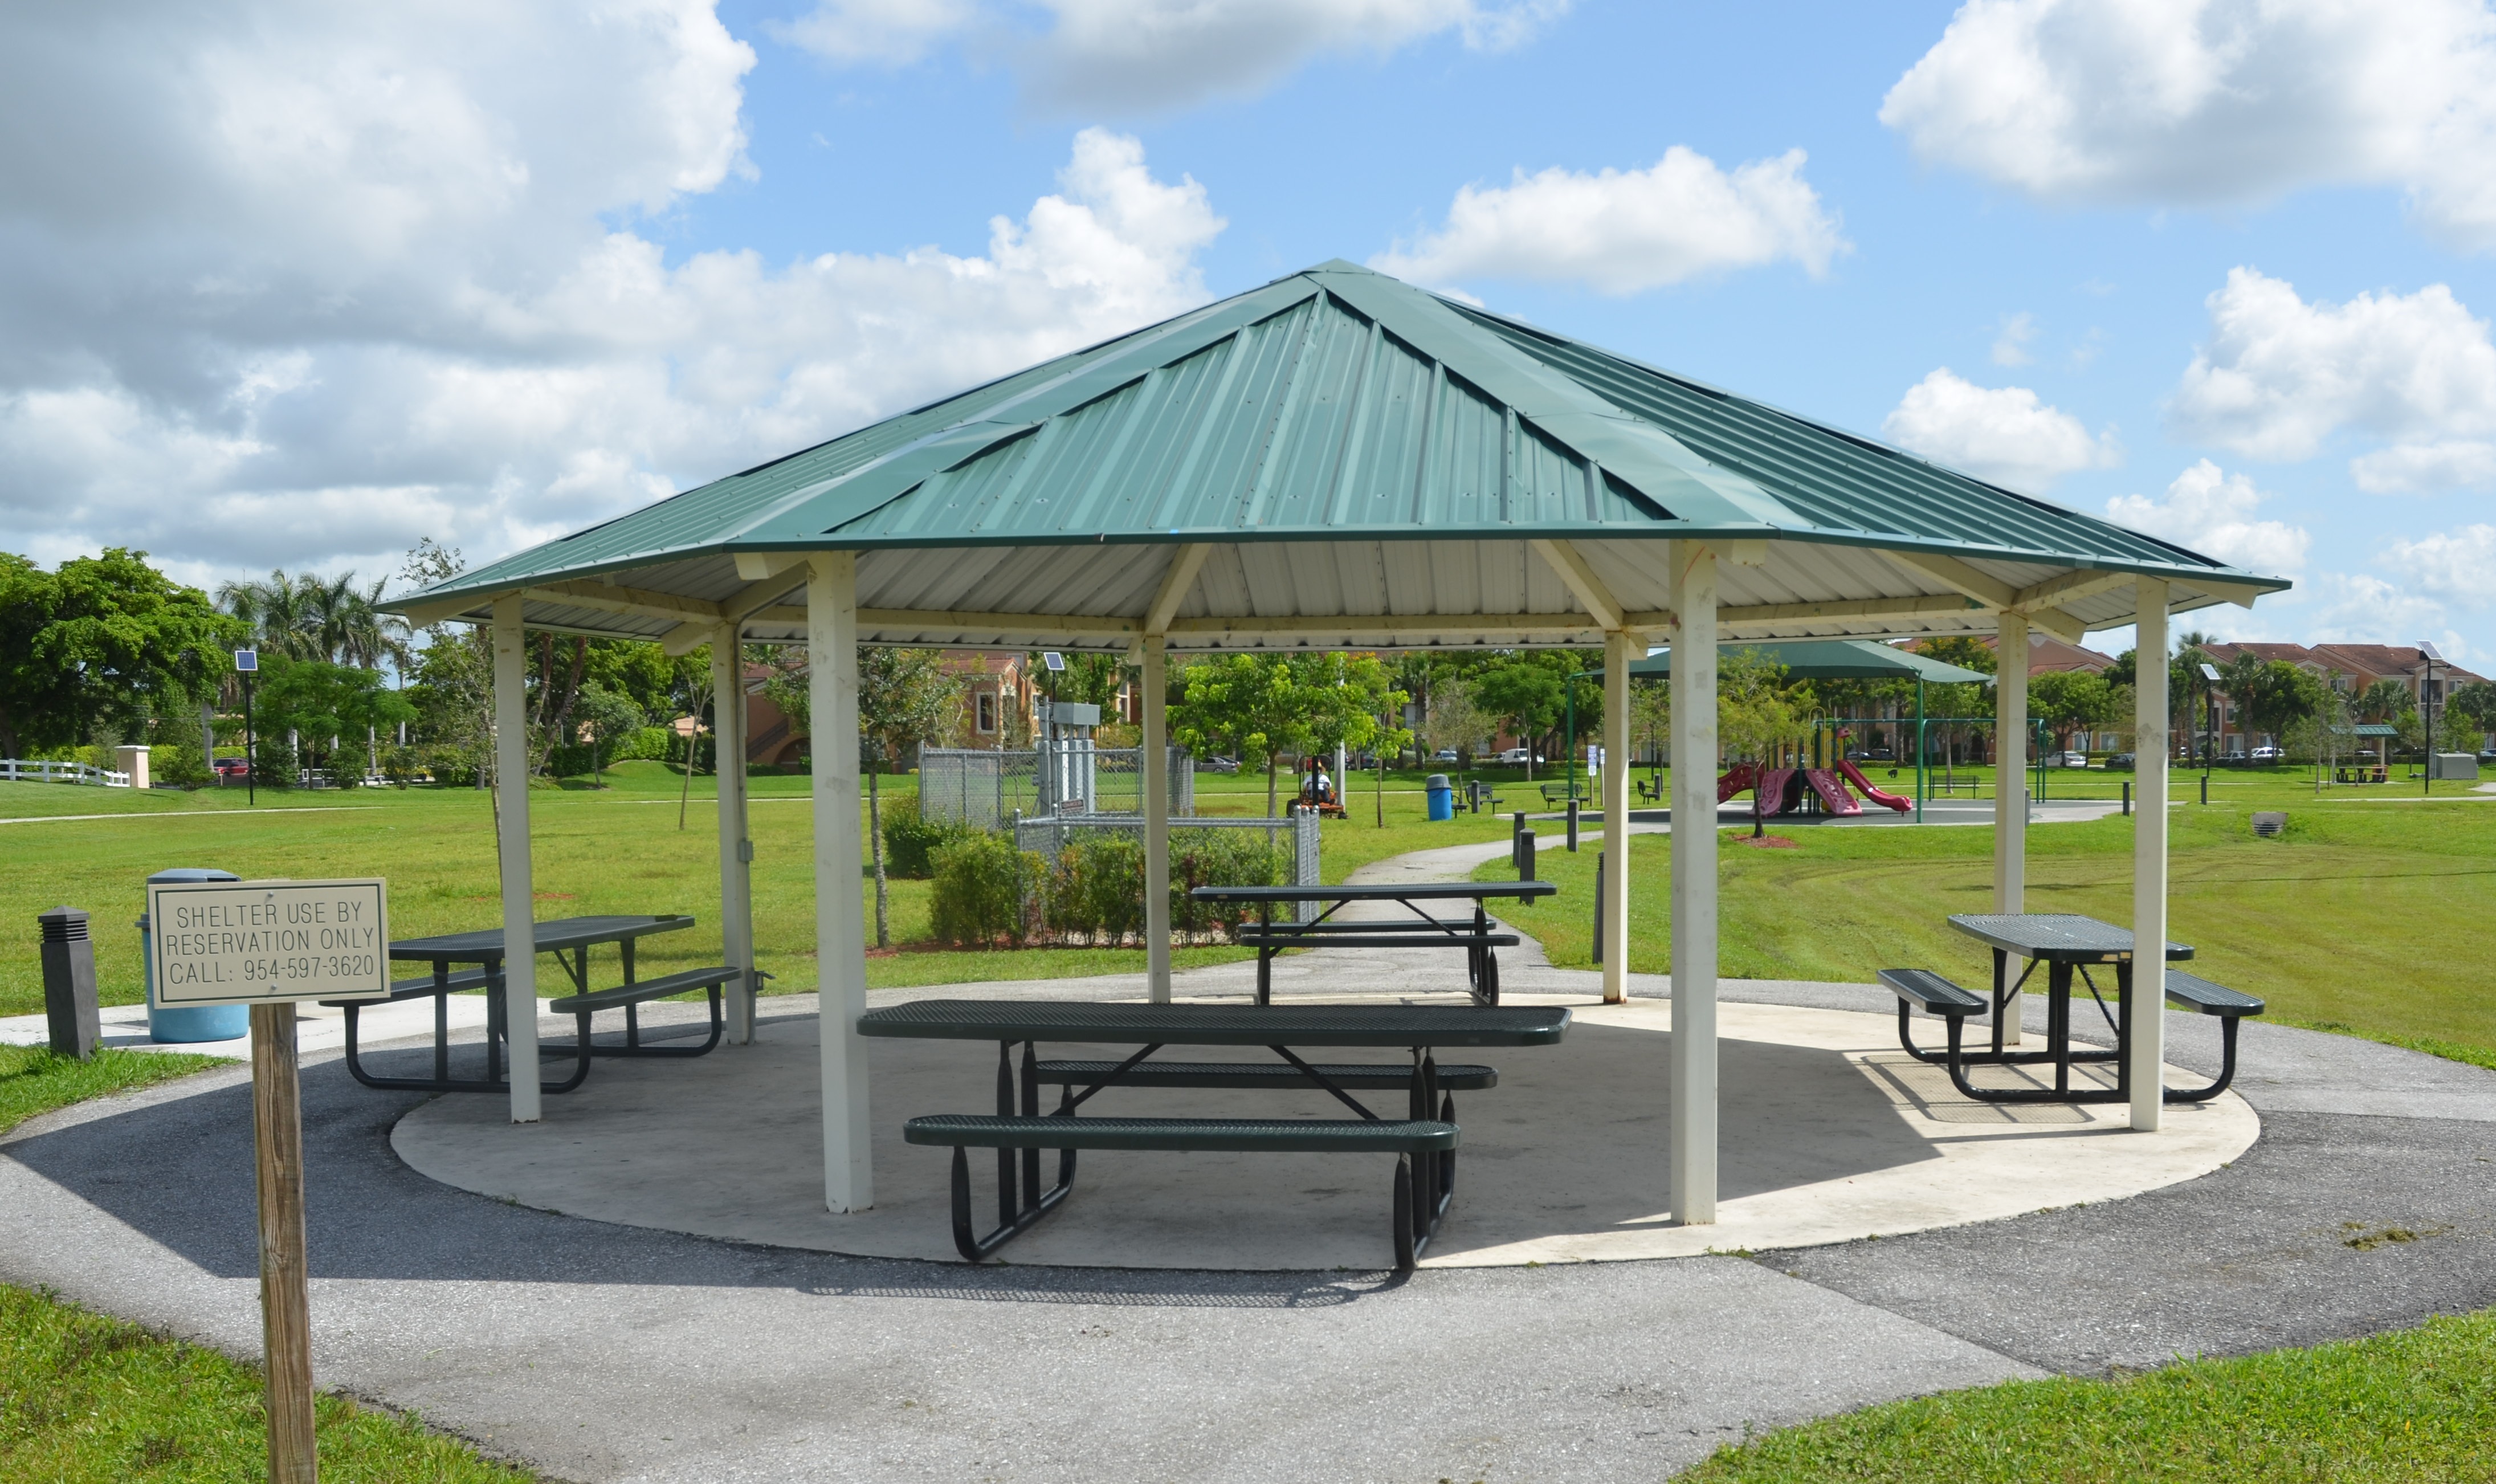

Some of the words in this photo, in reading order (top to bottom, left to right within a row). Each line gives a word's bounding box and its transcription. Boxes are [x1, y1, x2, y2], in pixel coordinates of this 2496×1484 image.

[177, 904, 277, 928] SHELTER
[287, 903, 326, 924] USE
[337, 901, 362, 923] BY
[166, 929, 309, 956] RESERVATION
[321, 927, 373, 950] ONLY
[170, 961, 233, 984] CALL:
[244, 955, 373, 981] 954-597-3620
